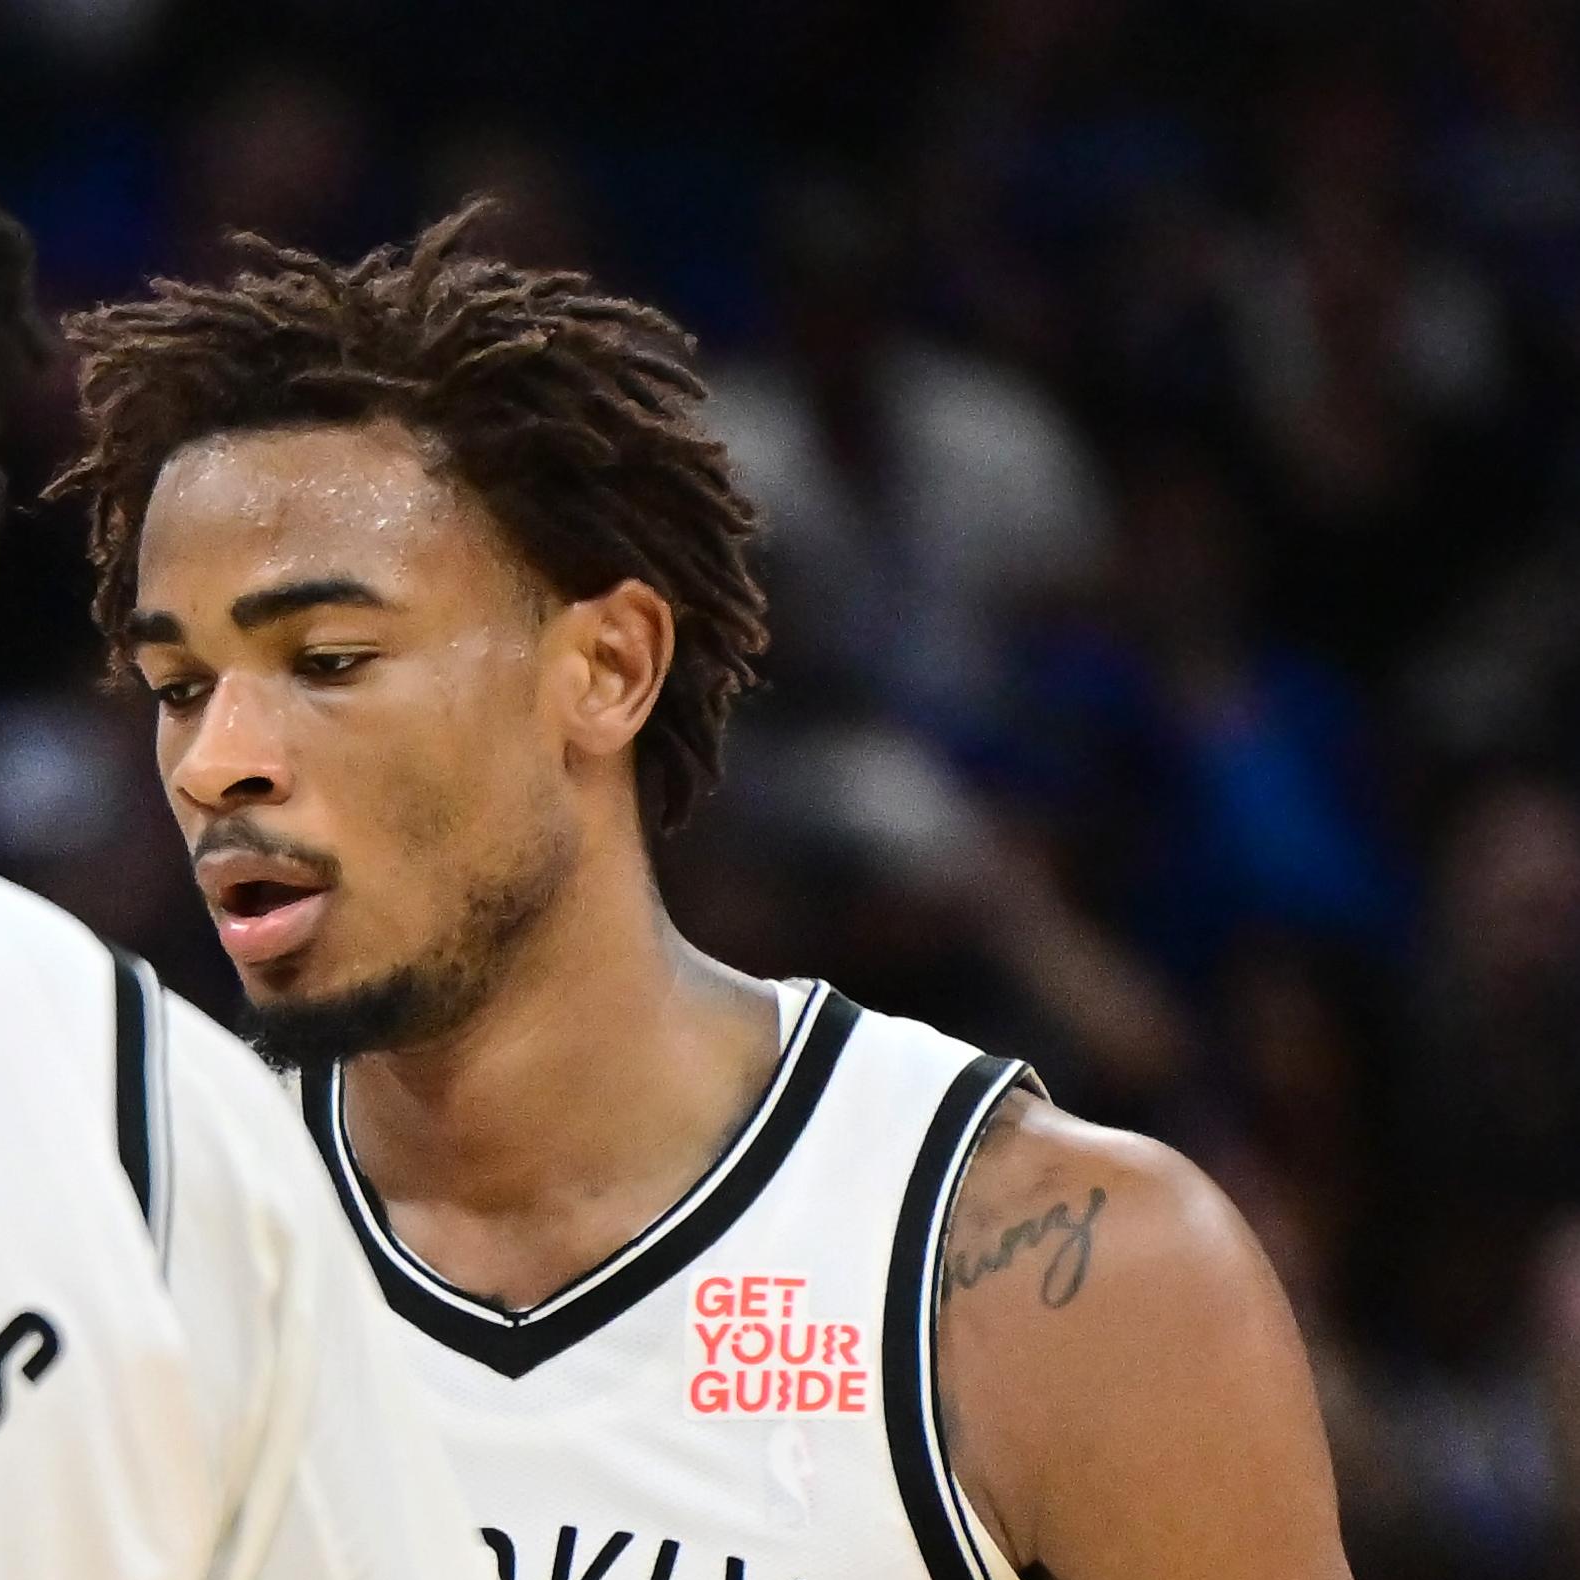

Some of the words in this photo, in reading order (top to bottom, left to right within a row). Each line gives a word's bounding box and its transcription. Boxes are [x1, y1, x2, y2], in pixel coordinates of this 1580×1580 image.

[694, 1275, 807, 1319] GET
[693, 1322, 861, 1367] YOUR
[689, 1369, 868, 1414] GUIDE
